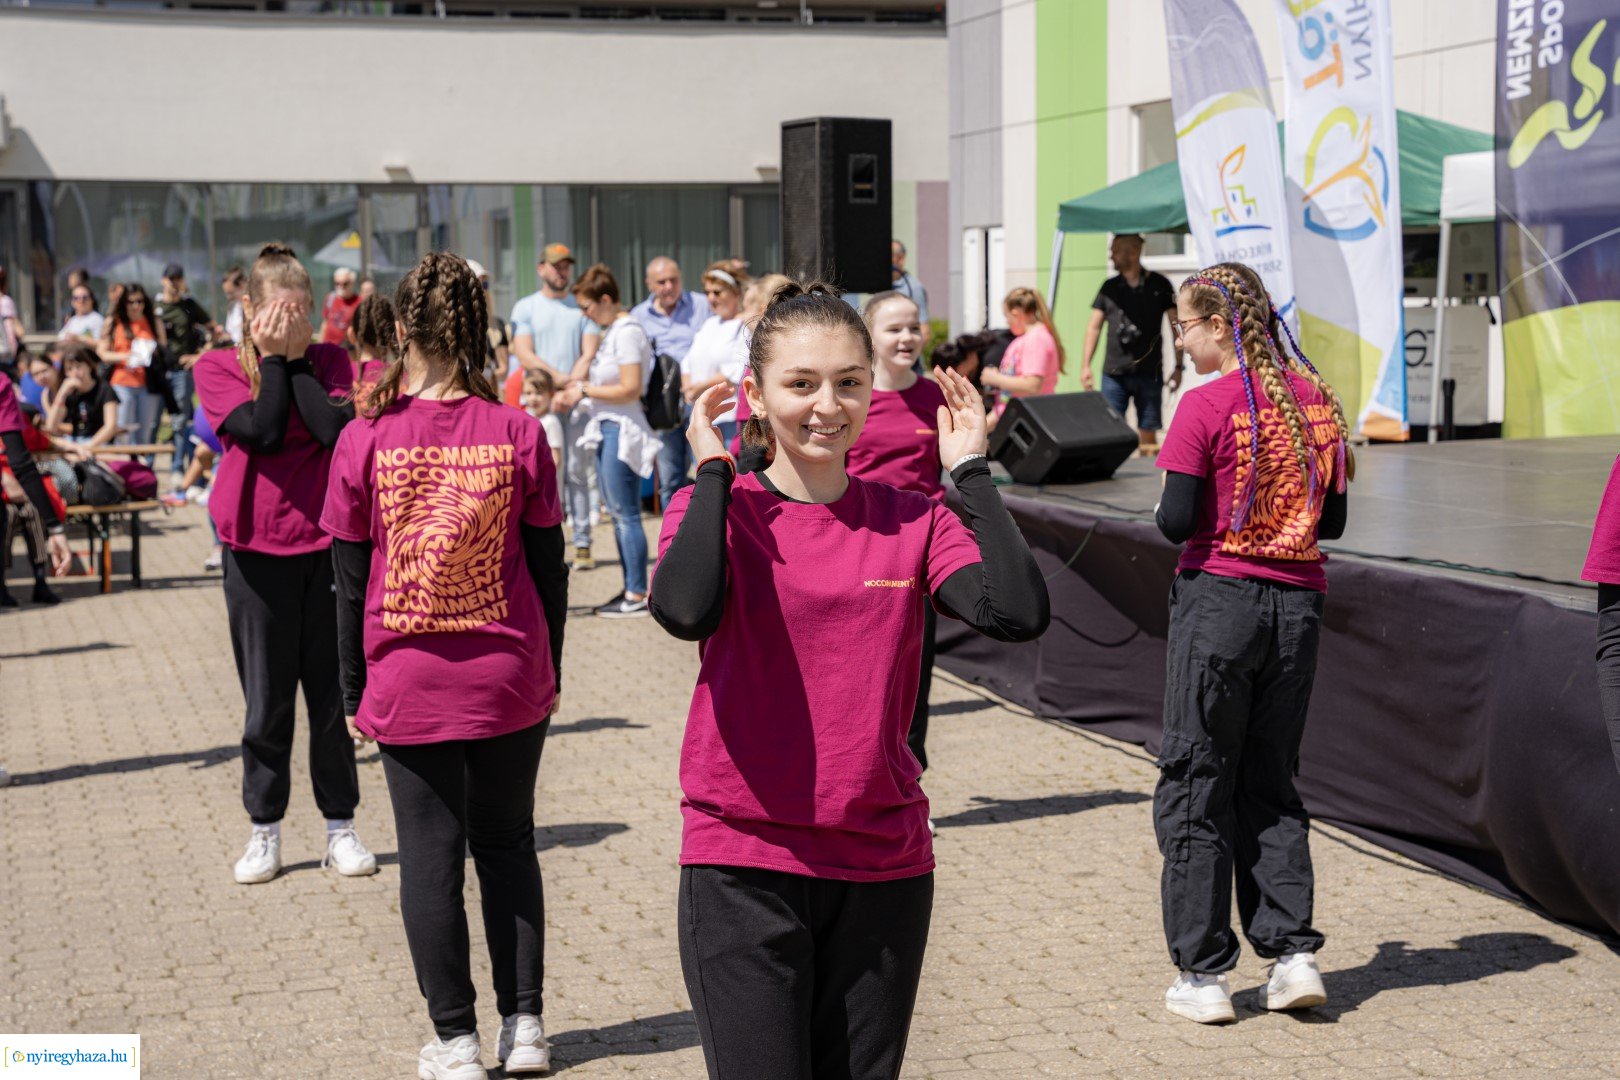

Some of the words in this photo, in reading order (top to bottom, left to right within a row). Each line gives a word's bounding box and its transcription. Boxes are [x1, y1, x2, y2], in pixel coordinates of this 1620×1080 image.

[376, 445, 514, 469] NOCOMMENT
[377, 465, 514, 493] NOCOMMENT
[383, 580, 504, 615] NOCOMMENT
[864, 580, 910, 588] NOCOMMENT
[383, 599, 508, 634] NOCOMMENT
